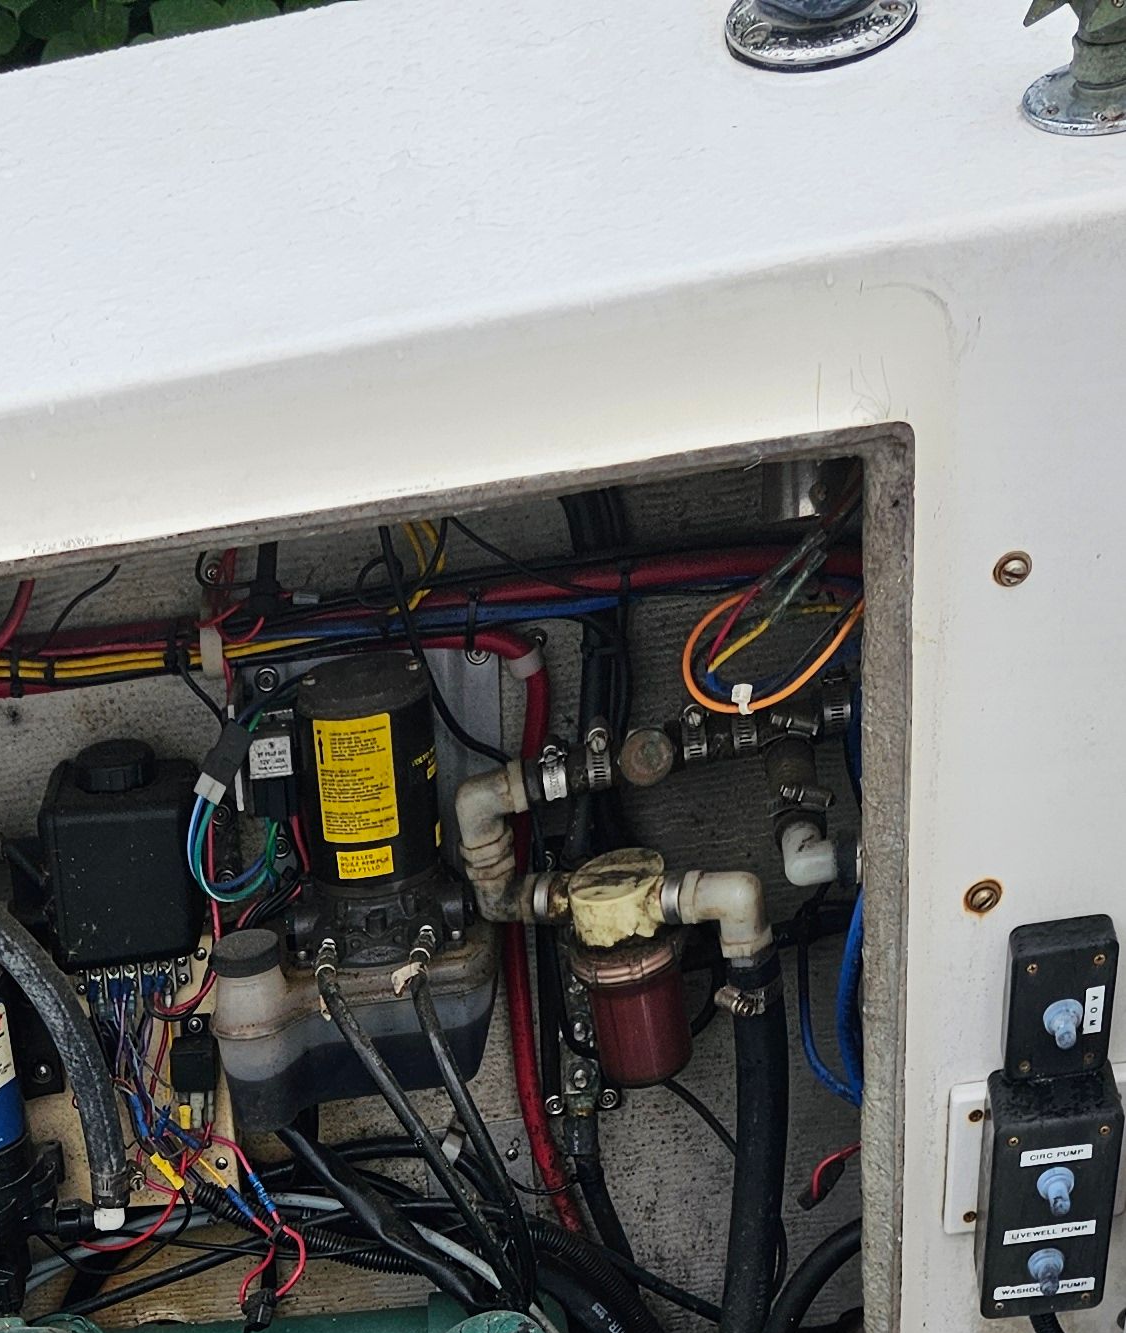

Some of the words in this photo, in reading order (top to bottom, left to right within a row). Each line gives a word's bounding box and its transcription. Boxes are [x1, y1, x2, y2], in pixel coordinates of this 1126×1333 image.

[1029, 1152, 1053, 1161] CIRC
[1057, 1148, 1084, 1158] PUMP
[1011, 1228, 1058, 1240] LIVEWELL
[1061, 1224, 1088, 1233] PUMP
[1001, 1286, 1041, 1295] WASHDO
[1060, 1280, 1087, 1289] PUMP
